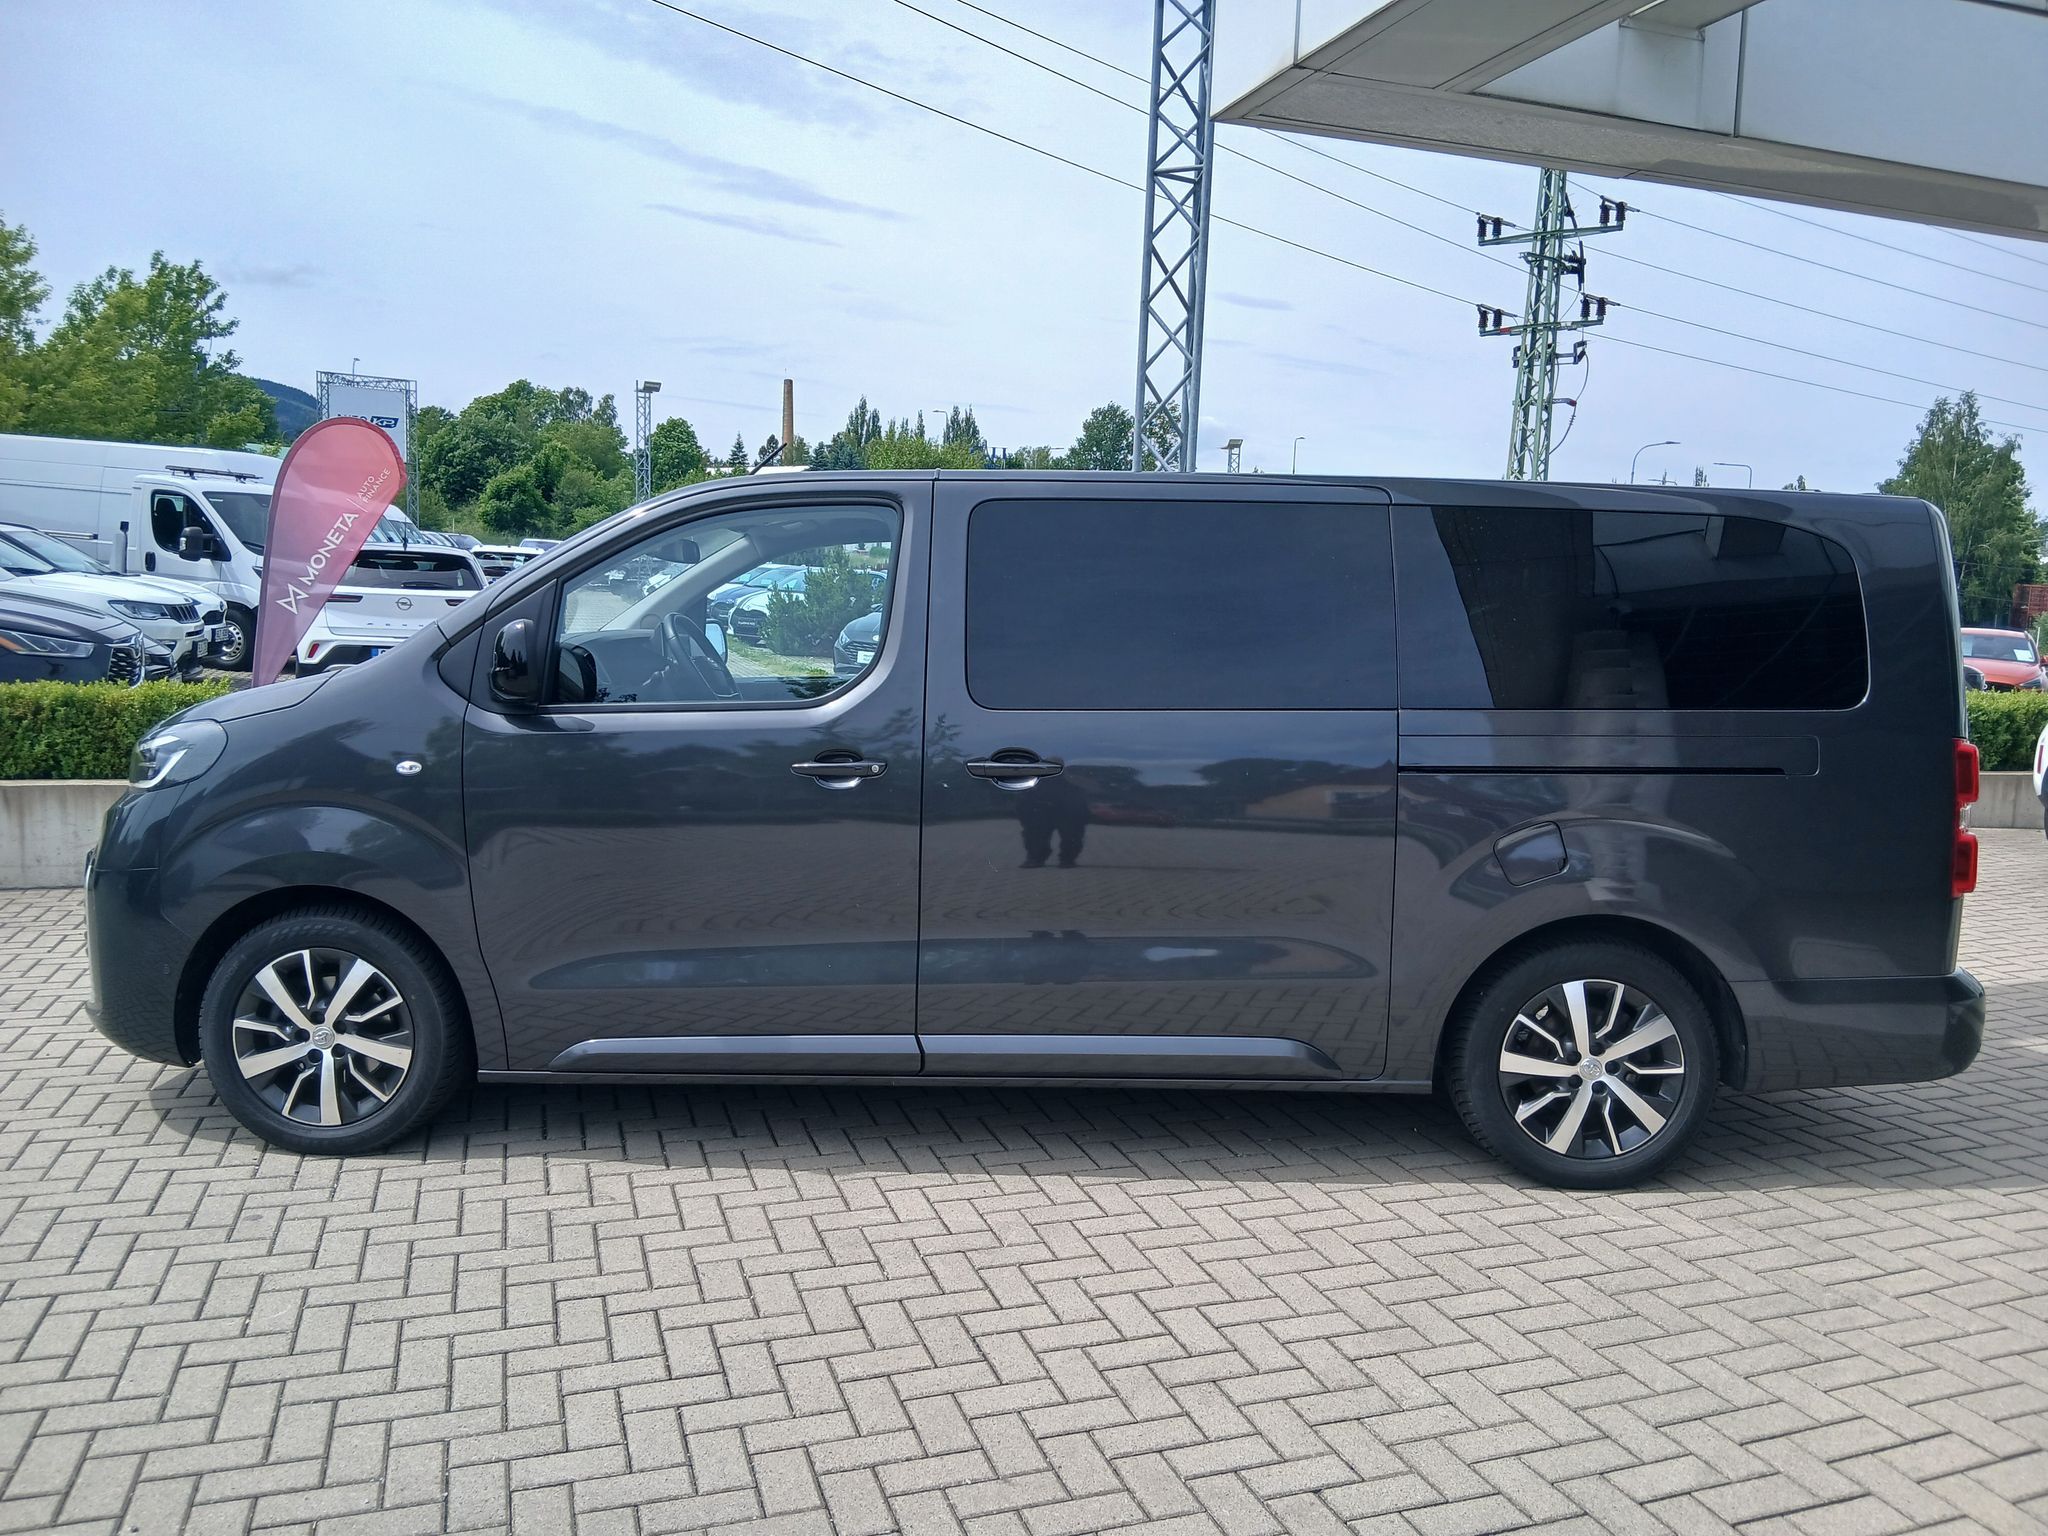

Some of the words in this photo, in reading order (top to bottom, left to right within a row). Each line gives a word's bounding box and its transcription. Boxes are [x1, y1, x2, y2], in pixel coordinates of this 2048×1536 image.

[357, 476, 375, 499] AUTO
[363, 468, 391, 504] FINANCE
[298, 513, 359, 586] MONETA
